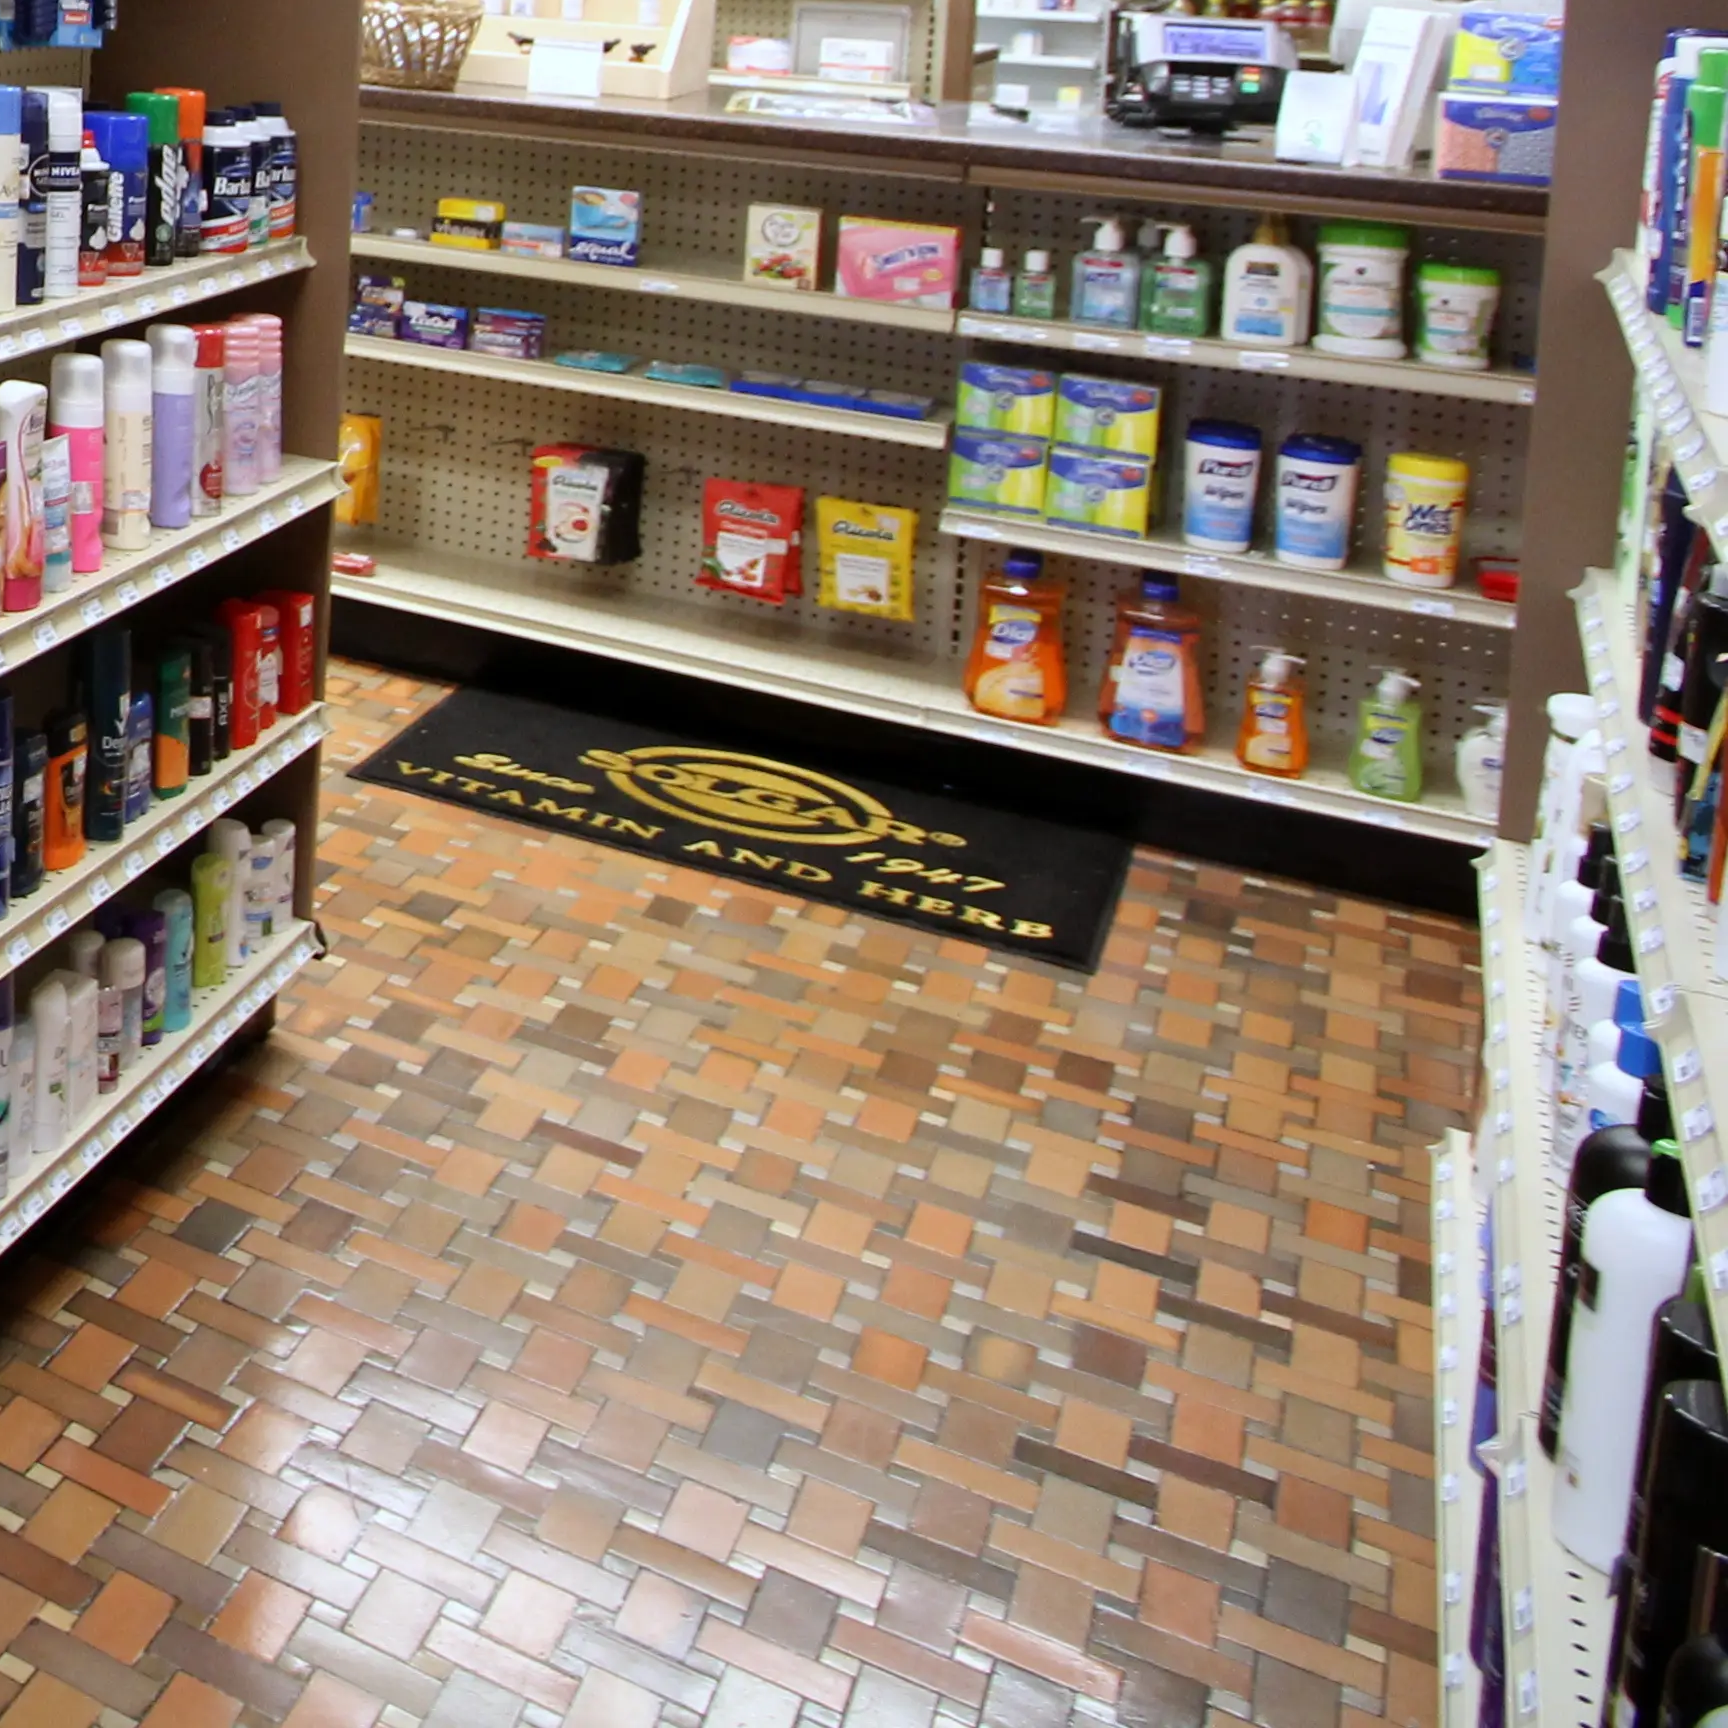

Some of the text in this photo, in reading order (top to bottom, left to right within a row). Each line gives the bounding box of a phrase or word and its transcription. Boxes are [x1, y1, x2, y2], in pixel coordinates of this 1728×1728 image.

[51, 165, 80, 177] NIVEA
[107, 171, 124, 243] Gillette
[158, 143, 177, 223] edge
[571, 240, 636, 264] equal
[218, 695, 230, 728] AXE
[454, 751, 1007, 894] Since 1947
[578, 748, 931, 847] SOLGAR
[395, 758, 1057, 941] VITAMIN AND HERB
